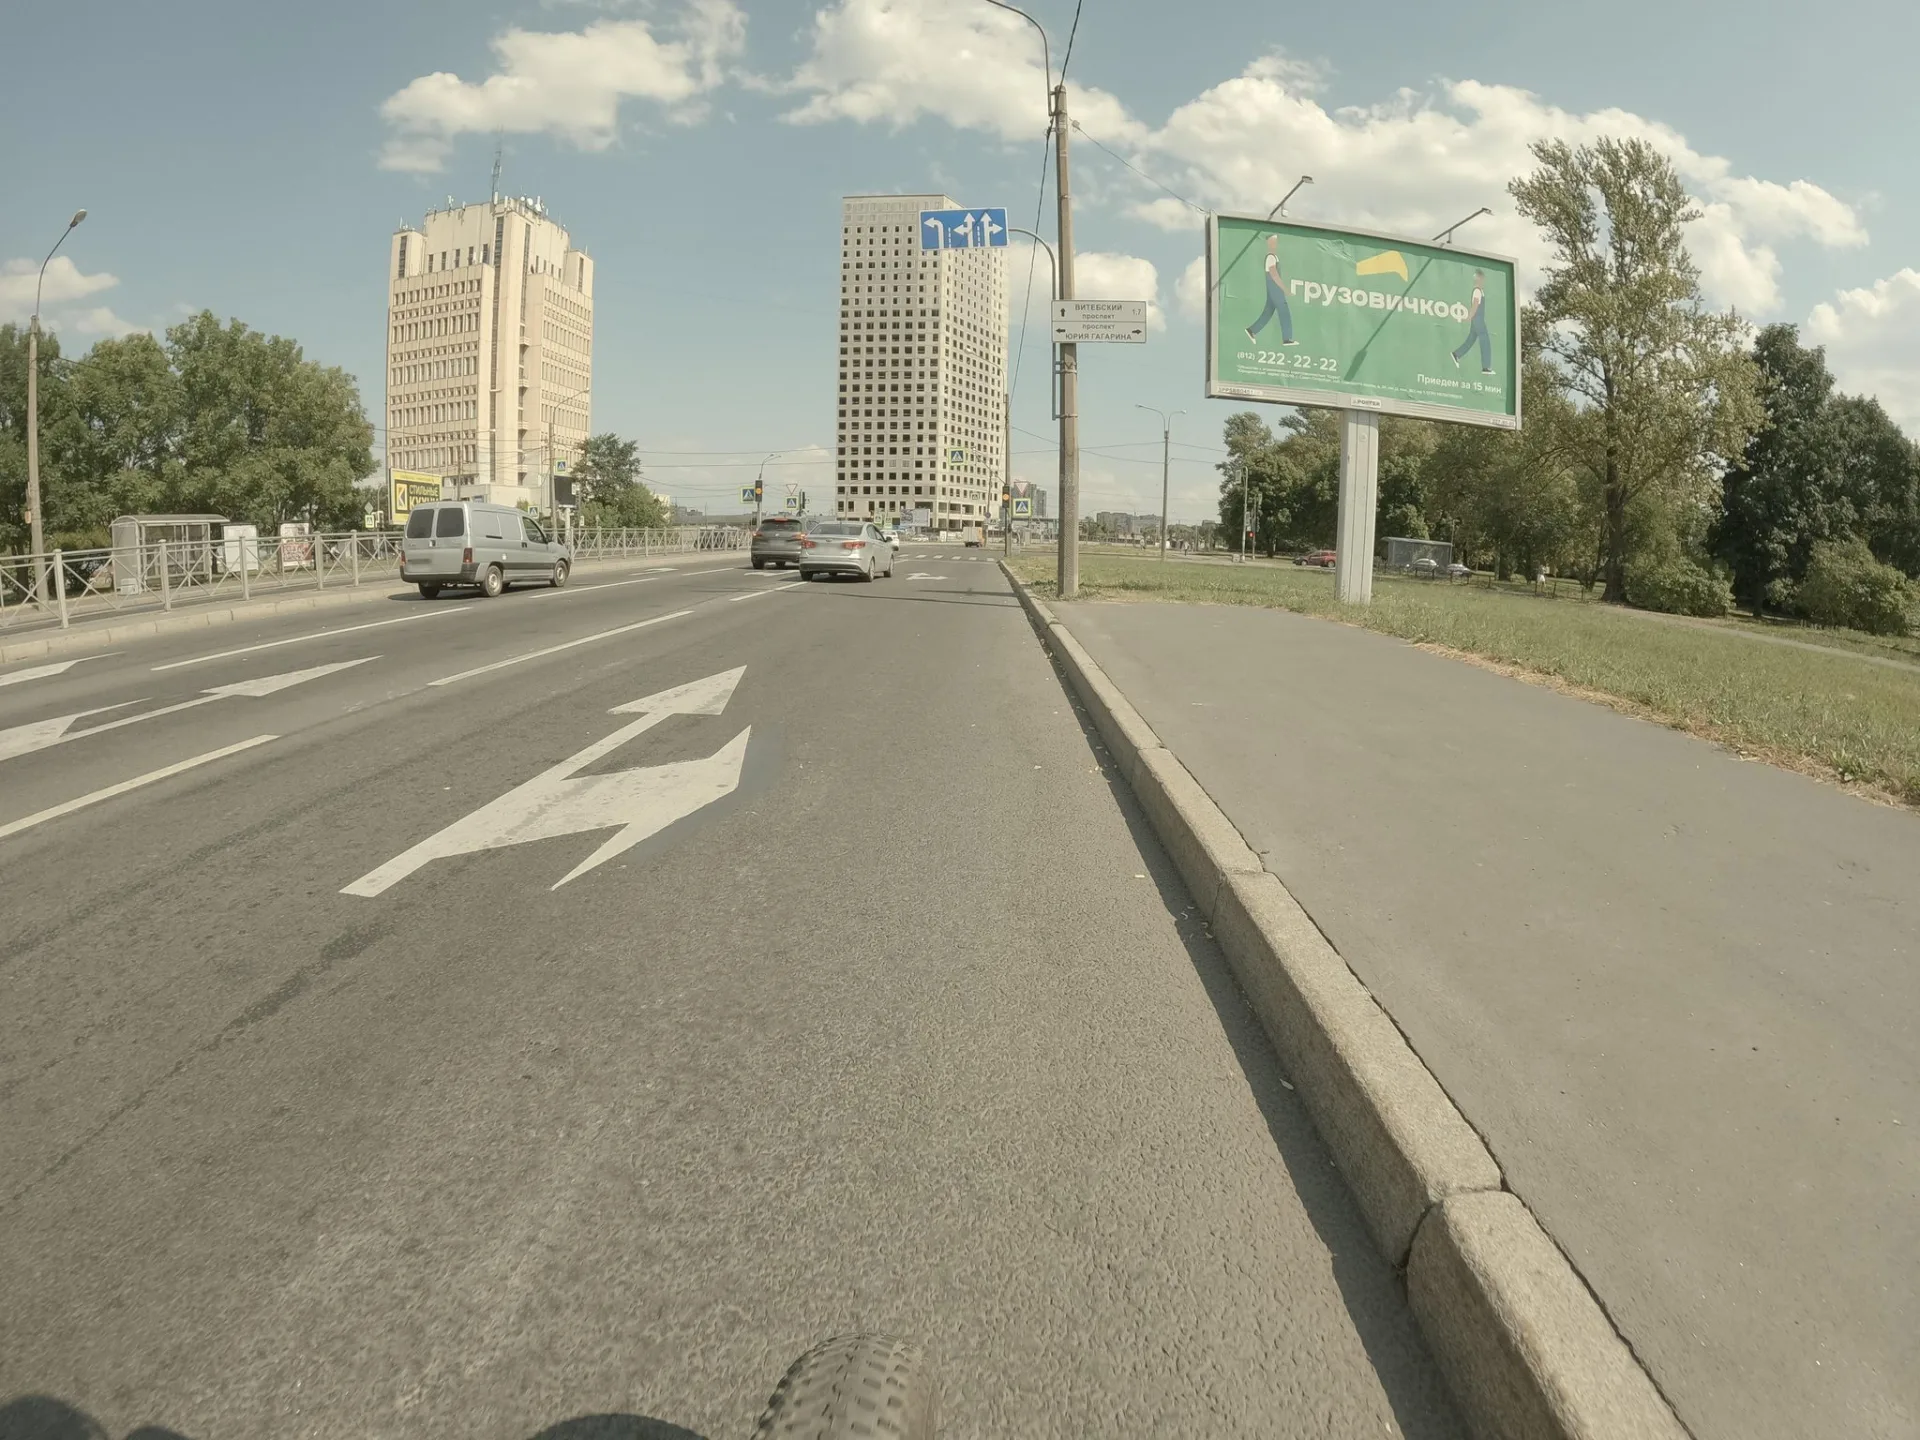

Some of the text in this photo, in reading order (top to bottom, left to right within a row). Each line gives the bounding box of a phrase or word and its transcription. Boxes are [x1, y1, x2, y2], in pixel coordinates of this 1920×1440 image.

[1075, 303, 1122, 311] ВИТЕБСКИЙ
[1290, 279, 1469, 323] грузовичкоф
[1237, 352, 1255, 360] (812)
[1417, 373, 1502, 394] Приедем за 15 мин
